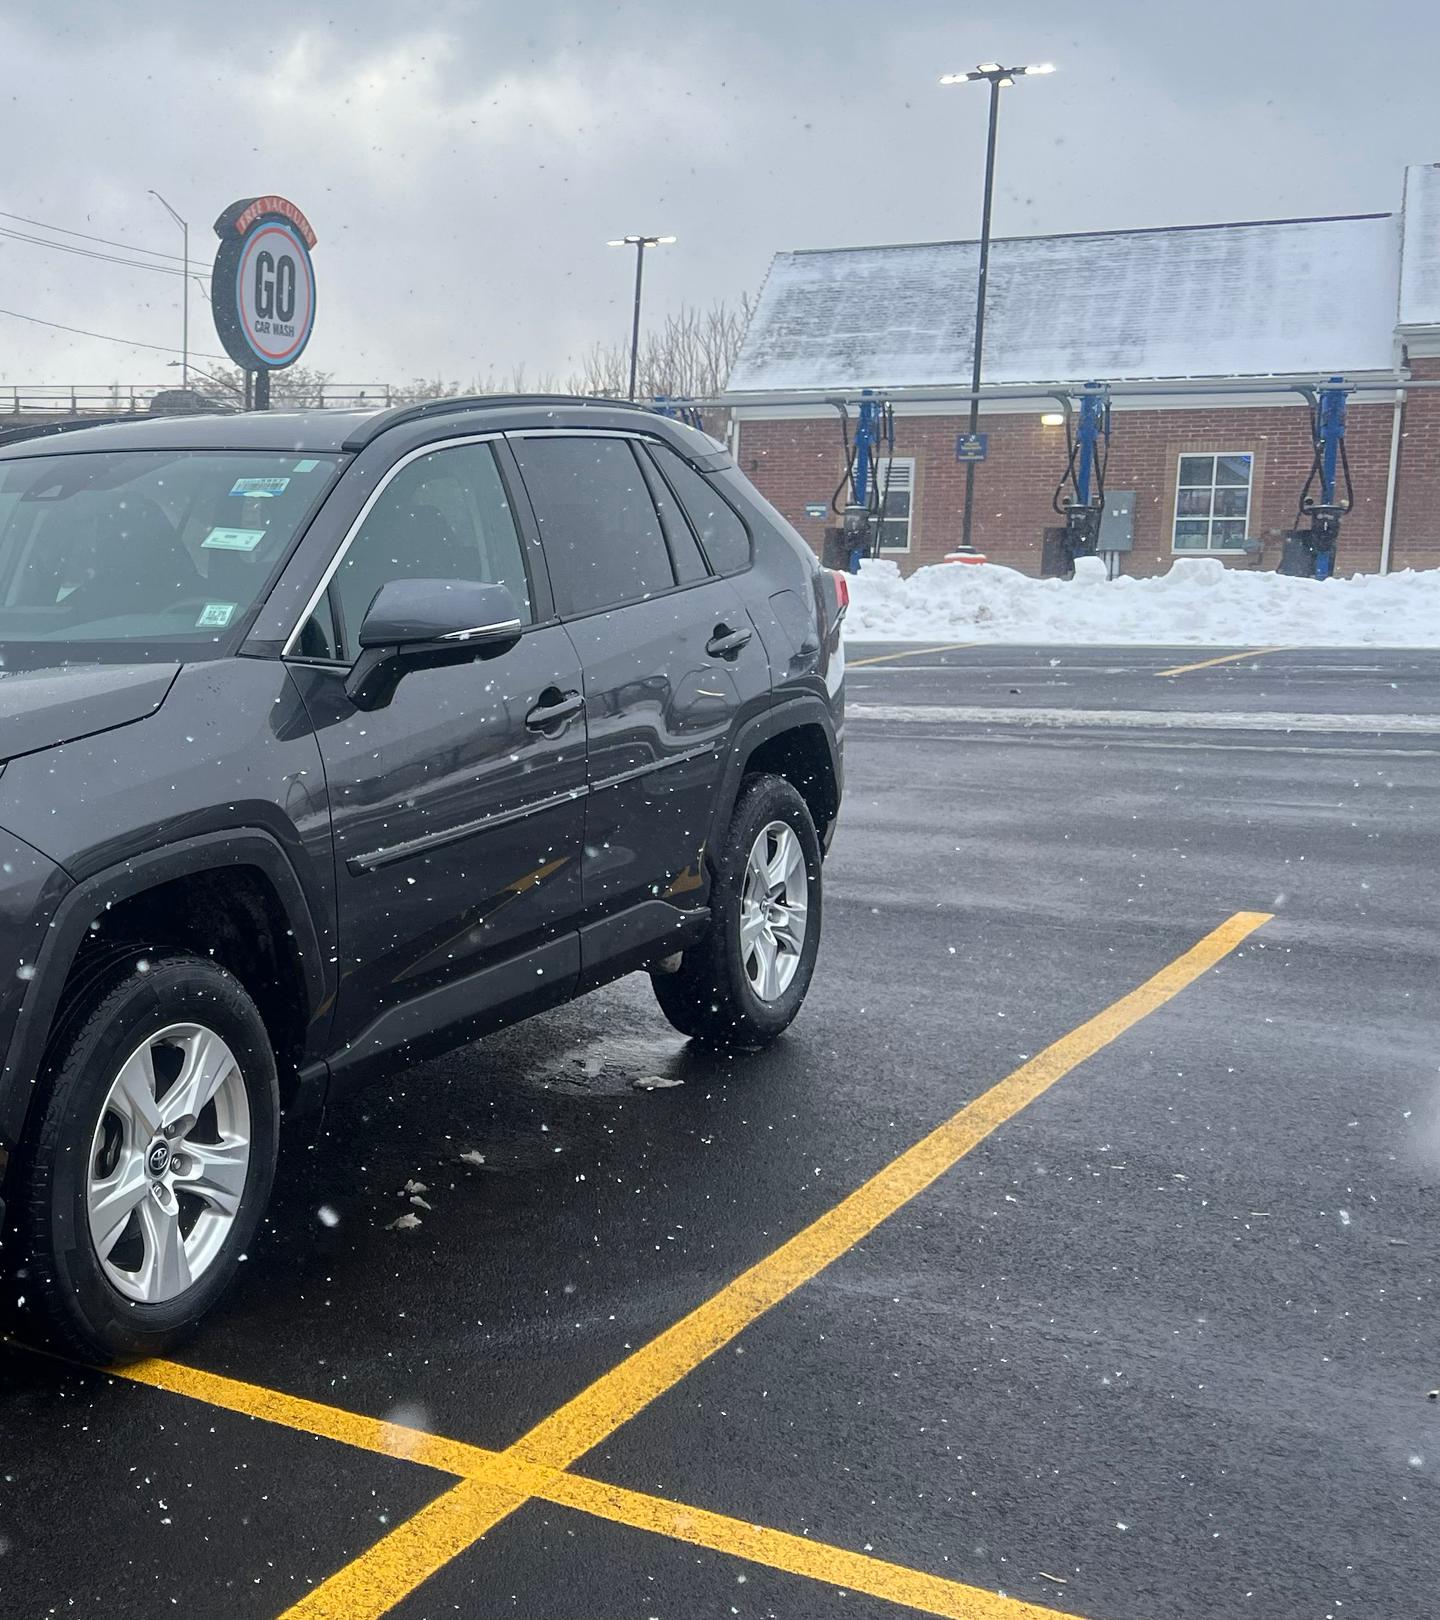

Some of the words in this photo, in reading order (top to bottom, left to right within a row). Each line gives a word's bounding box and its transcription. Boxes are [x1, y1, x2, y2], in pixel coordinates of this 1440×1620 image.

[240, 198, 264, 231] FREE
[265, 198, 315, 246] VACUUMS
[255, 250, 296, 322] GO
[255, 320, 271, 334] CAR
[272, 323, 295, 337] WASH
